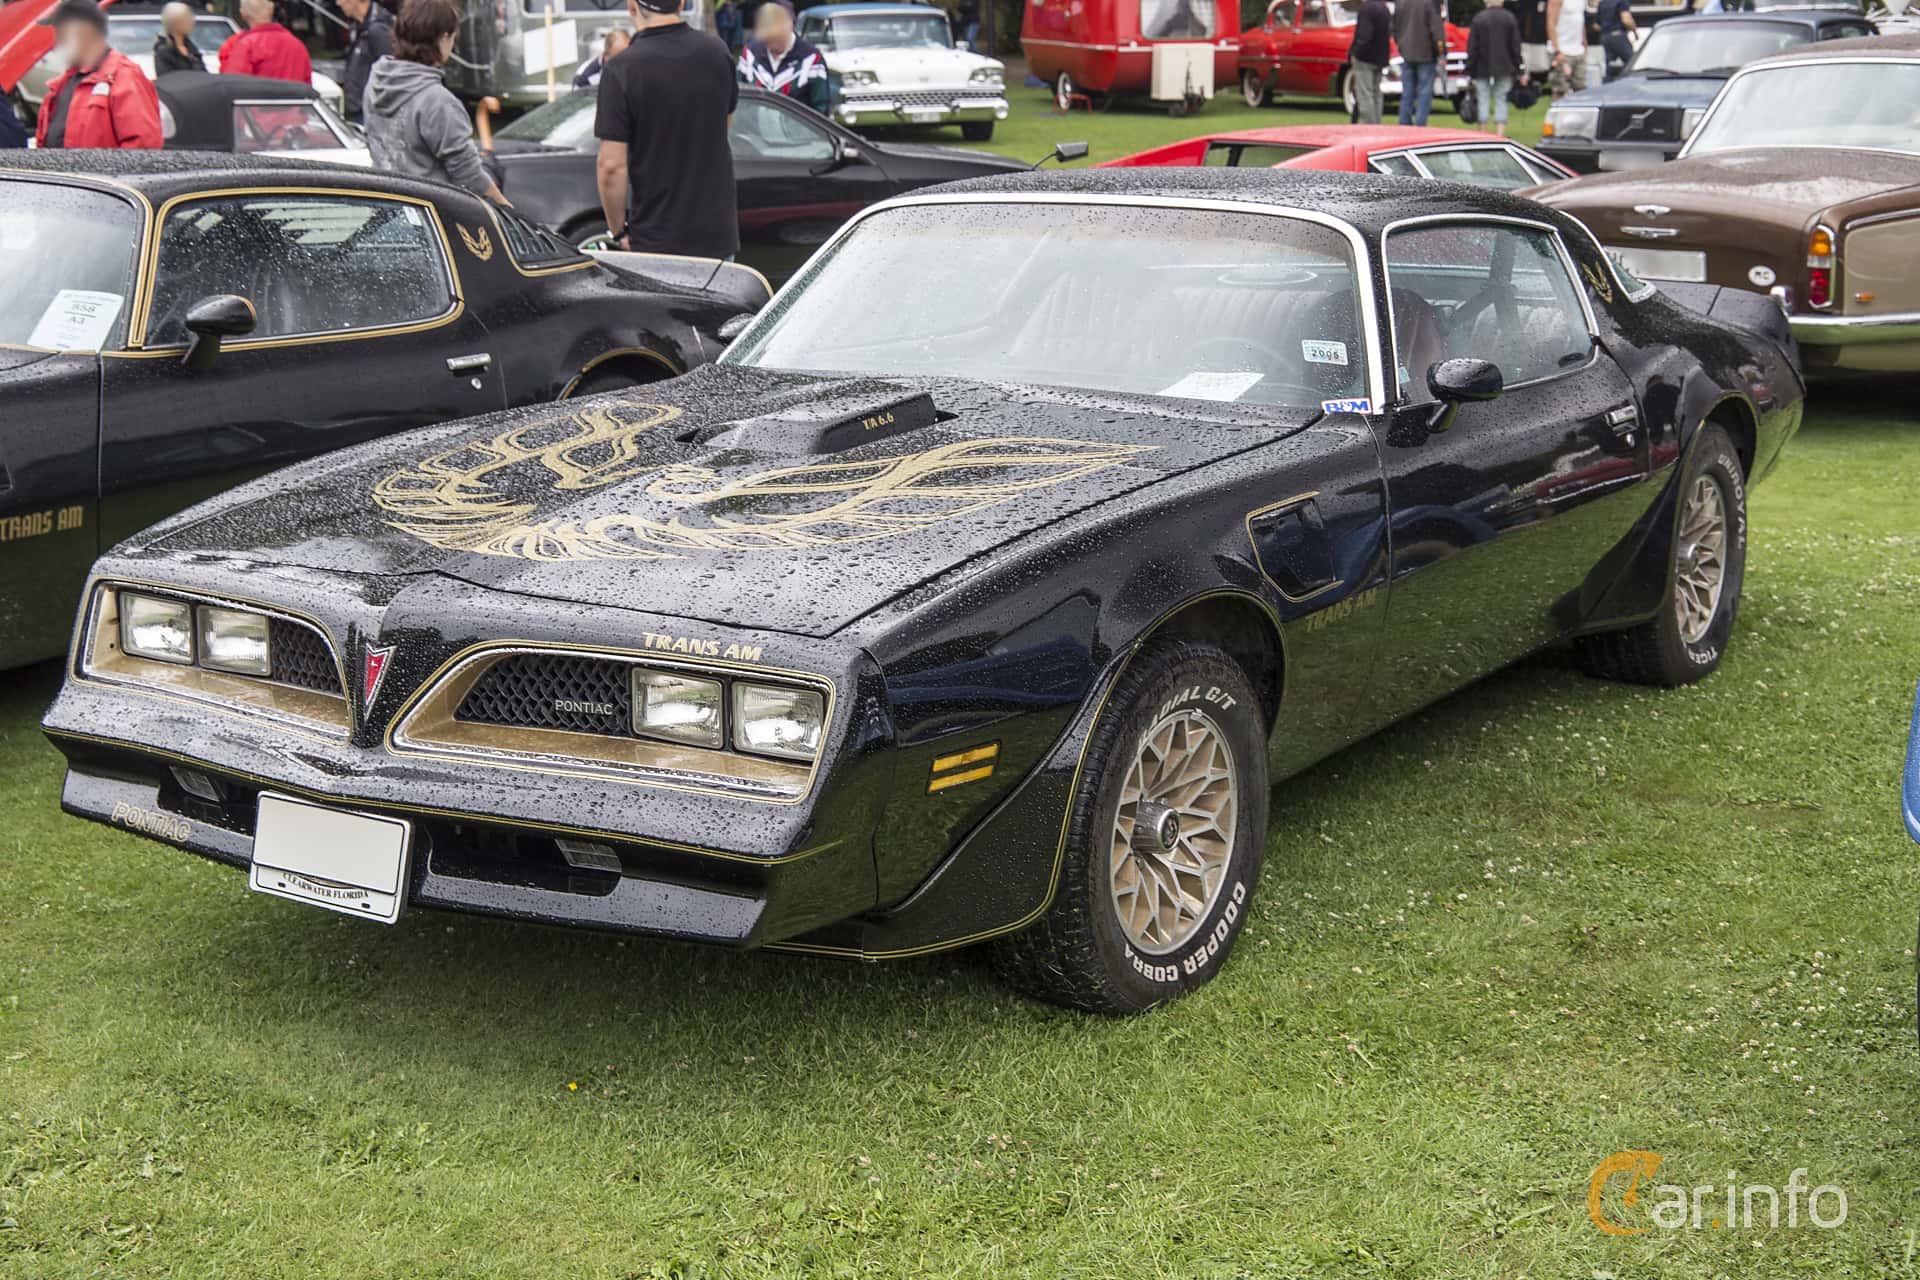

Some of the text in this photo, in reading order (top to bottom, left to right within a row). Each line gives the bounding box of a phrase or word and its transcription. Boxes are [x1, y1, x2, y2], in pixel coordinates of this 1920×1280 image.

[878, 412, 894, 425] 6.6
[1718, 454, 1746, 549] UNIROYAL
[0, 505, 83, 541] TRANS AM
[642, 632, 763, 661] TRANS AM
[555, 699, 614, 715] PONTIAC
[1205, 686, 1236, 710] G/T
[111, 801, 192, 842] PONTIAC
[282, 872, 369, 899] CLEARWATER FLORIDA
[1124, 881, 1247, 982] COOPER COBRA
